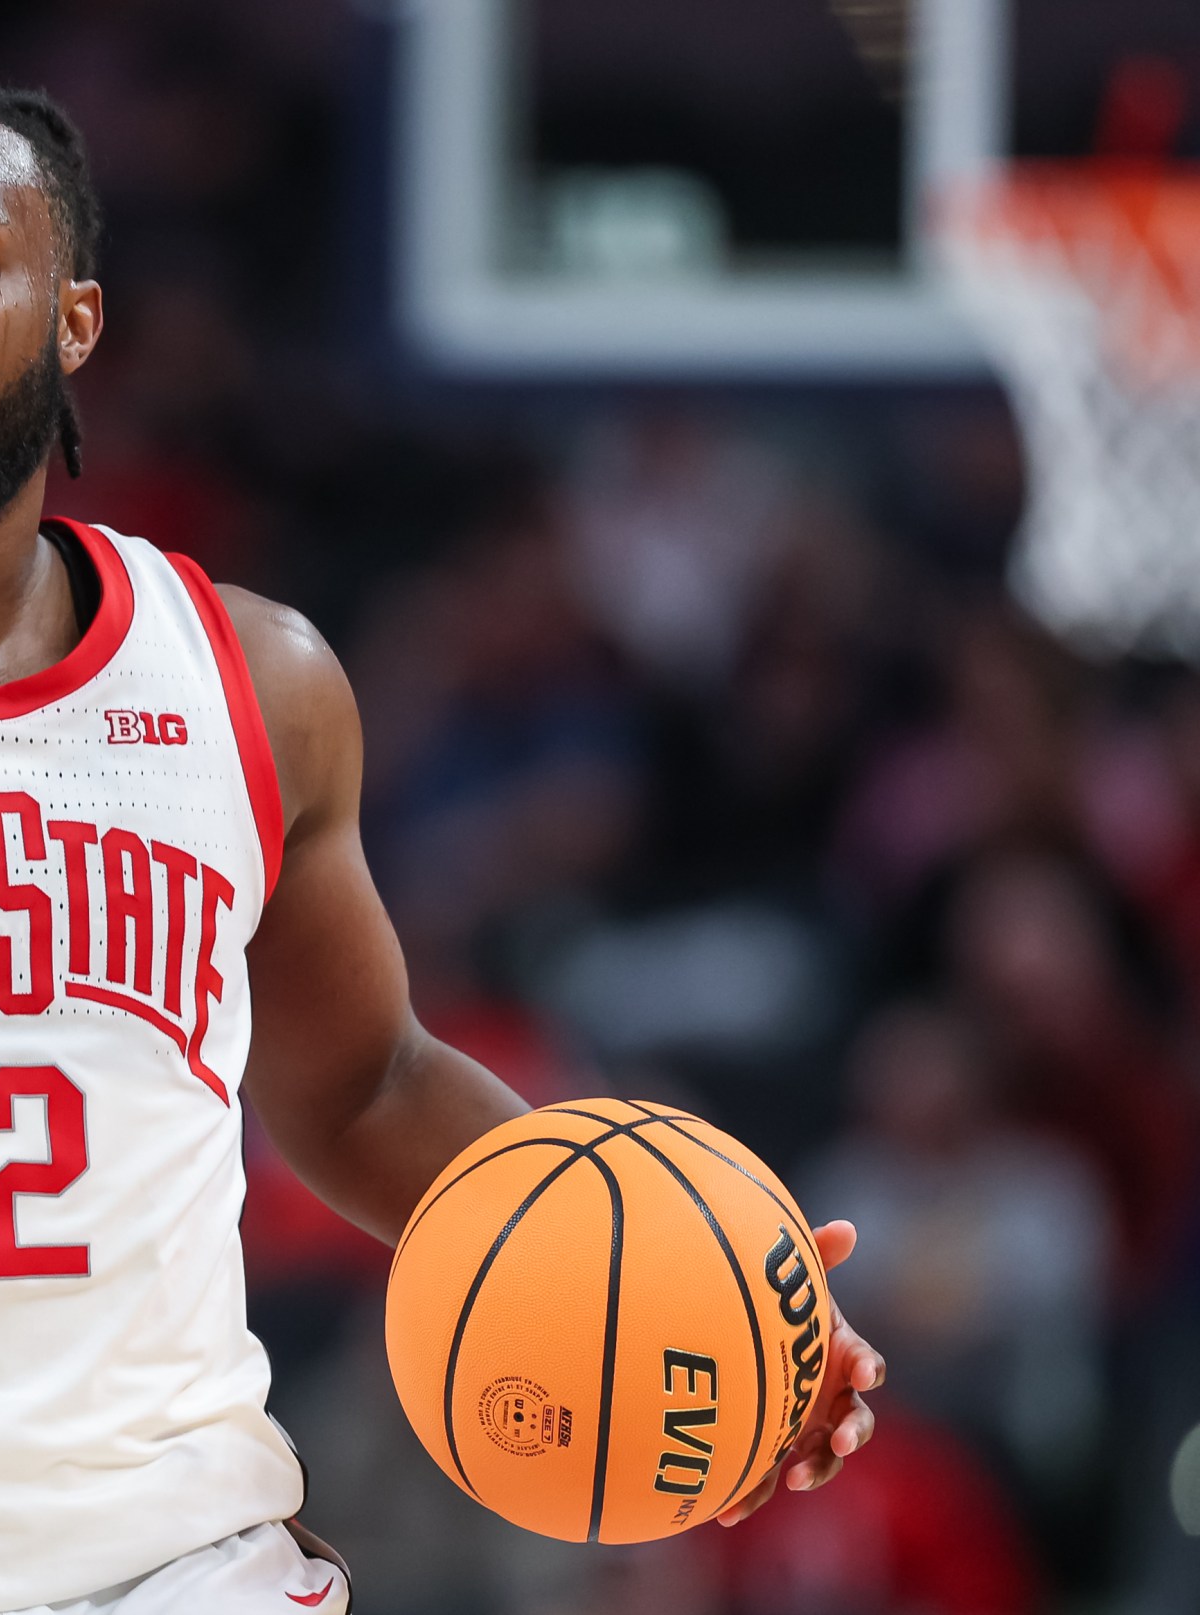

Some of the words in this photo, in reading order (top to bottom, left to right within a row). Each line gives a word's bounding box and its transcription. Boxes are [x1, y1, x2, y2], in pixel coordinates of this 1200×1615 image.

[763, 1222, 825, 1465] Wilso
[653, 1346, 719, 1496] EVO
[671, 1498, 698, 1526] NXT
